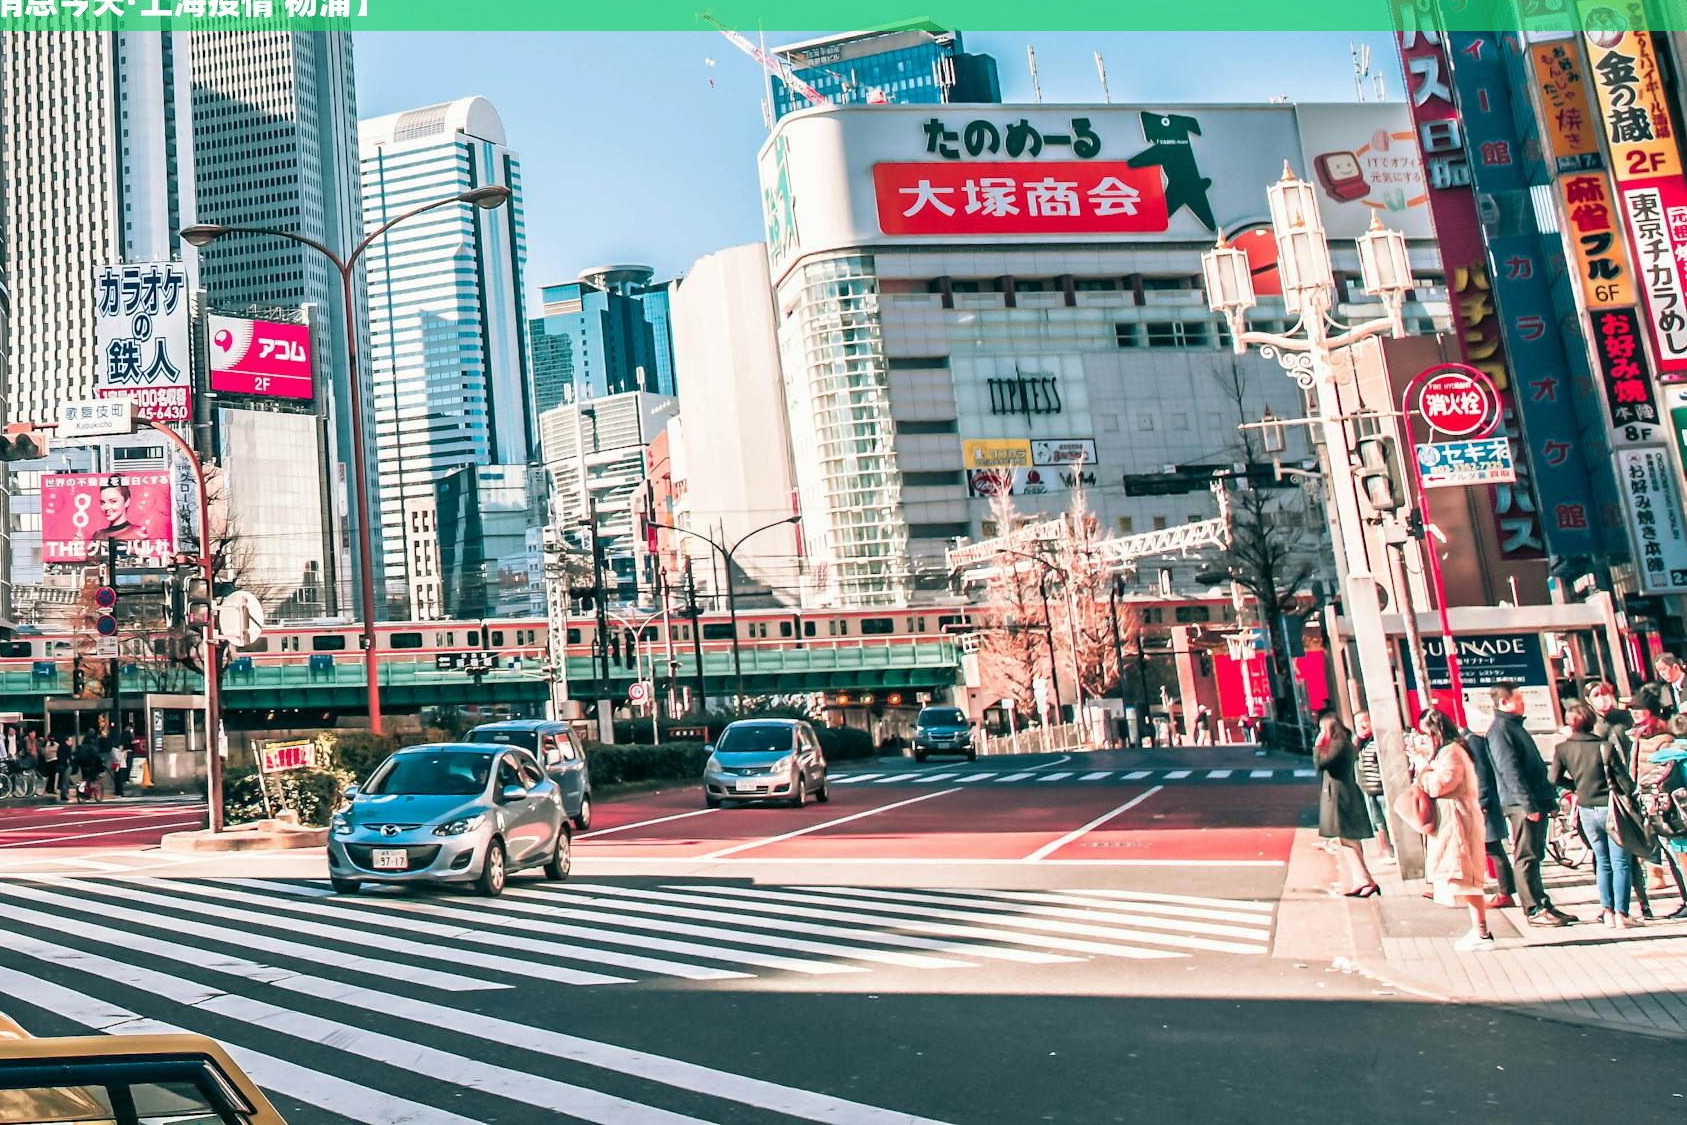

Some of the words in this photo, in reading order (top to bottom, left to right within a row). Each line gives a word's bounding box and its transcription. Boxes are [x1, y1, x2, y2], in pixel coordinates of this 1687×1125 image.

[1595, 50, 1655, 144] 金の蔵
[923, 117, 1102, 159] たのめーる
[1625, 149, 1667, 174] 2F
[898, 177, 1141, 218] 大塚商会
[1629, 193, 1687, 355] 東京チカラめし
[98, 265, 184, 317] カラオケ
[1595, 284, 1622, 302] 6F
[133, 311, 152, 338] の
[107, 336, 180, 385] 鉄人
[257, 337, 307, 363] アコム
[1600, 313, 1648, 404] お好み焼
[254, 376, 271, 391] 2F
[1505, 256, 1588, 530] カラオケ館
[65, 403, 124, 420] 歌舞伎町
[1426, 391, 1482, 417] 消火栓
[76, 421, 113, 430] Kabukicho
[1624, 425, 1653, 442] 8F
[1442, 440, 1510, 465] セキネ
[1628, 465, 1665, 573] お好み焼き本陣
[1422, 638, 1526, 658] UNADE
